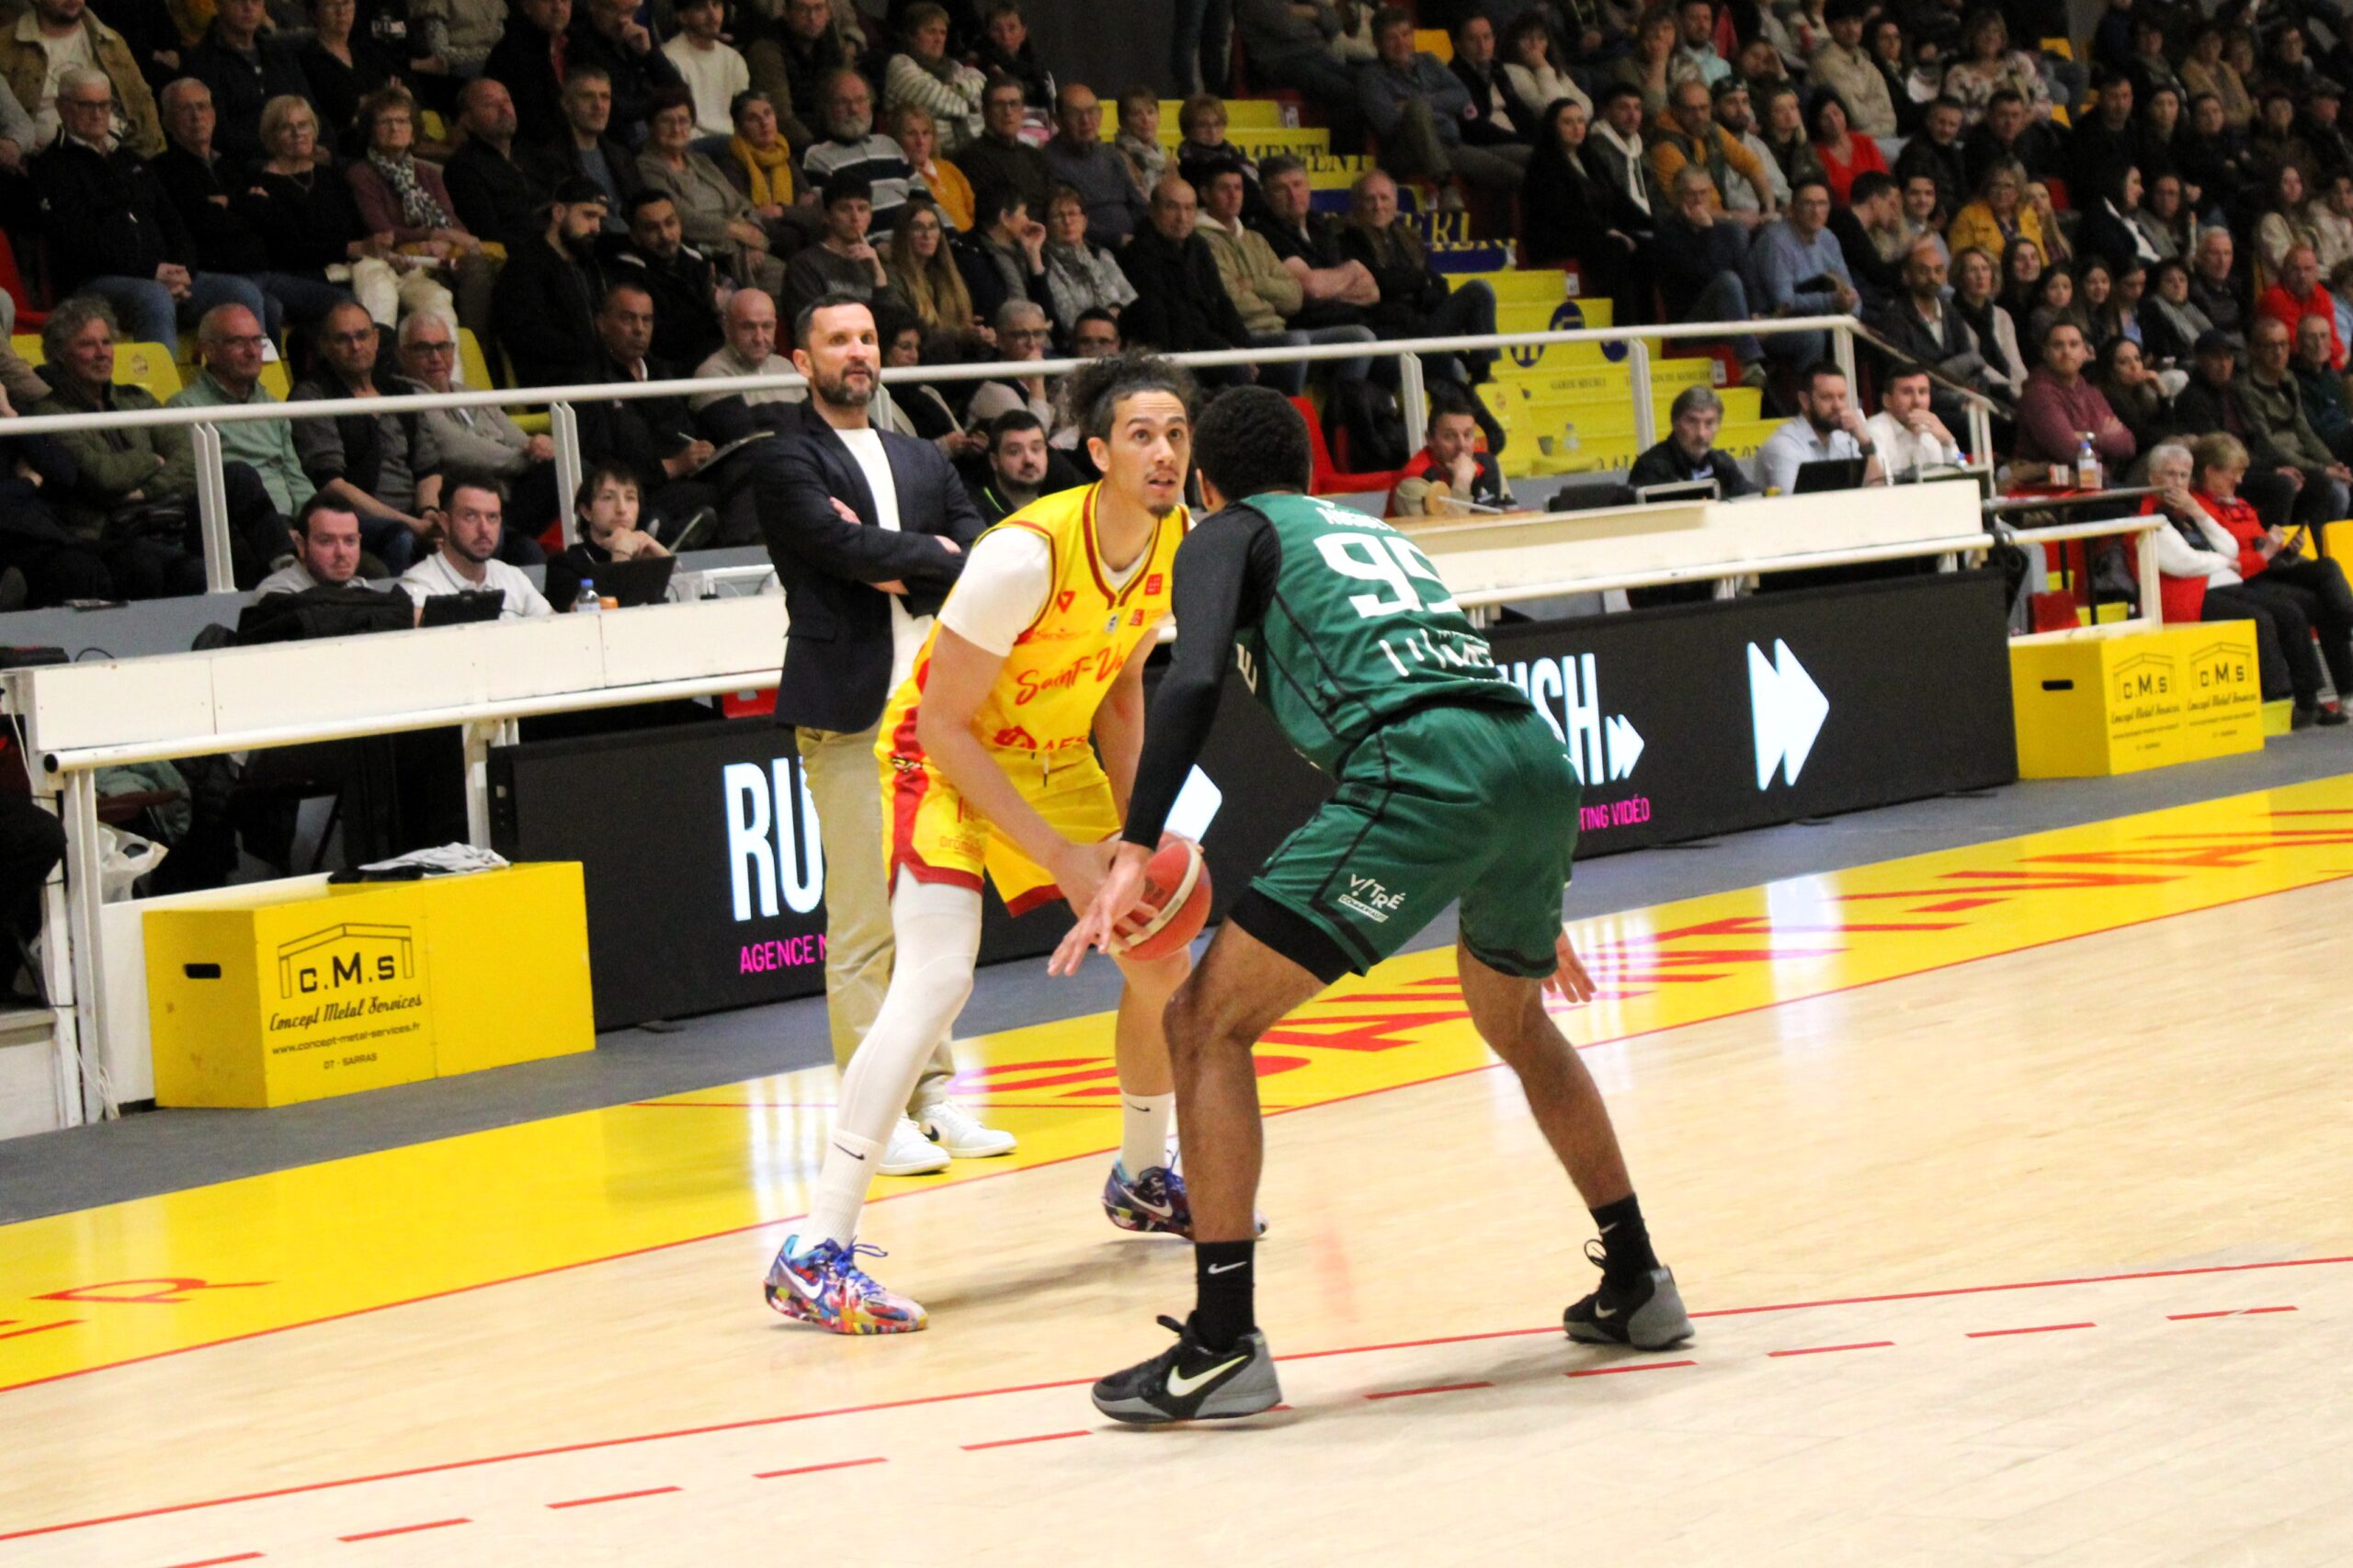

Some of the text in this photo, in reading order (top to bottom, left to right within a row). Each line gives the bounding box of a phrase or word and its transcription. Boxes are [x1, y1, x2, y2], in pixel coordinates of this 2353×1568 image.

[1496, 653, 1605, 786] SH
[1579, 793, 1650, 831] TING VIDÉO
[723, 756, 825, 922] RU
[299, 951, 396, 994] C.M.S
[740, 935, 815, 974] AGENCE
[269, 994, 423, 1031] Concept Metal Services
[272, 1021, 421, 1055] www.concept-metal-services.fr
[343, 1052, 378, 1067] SARRAS
